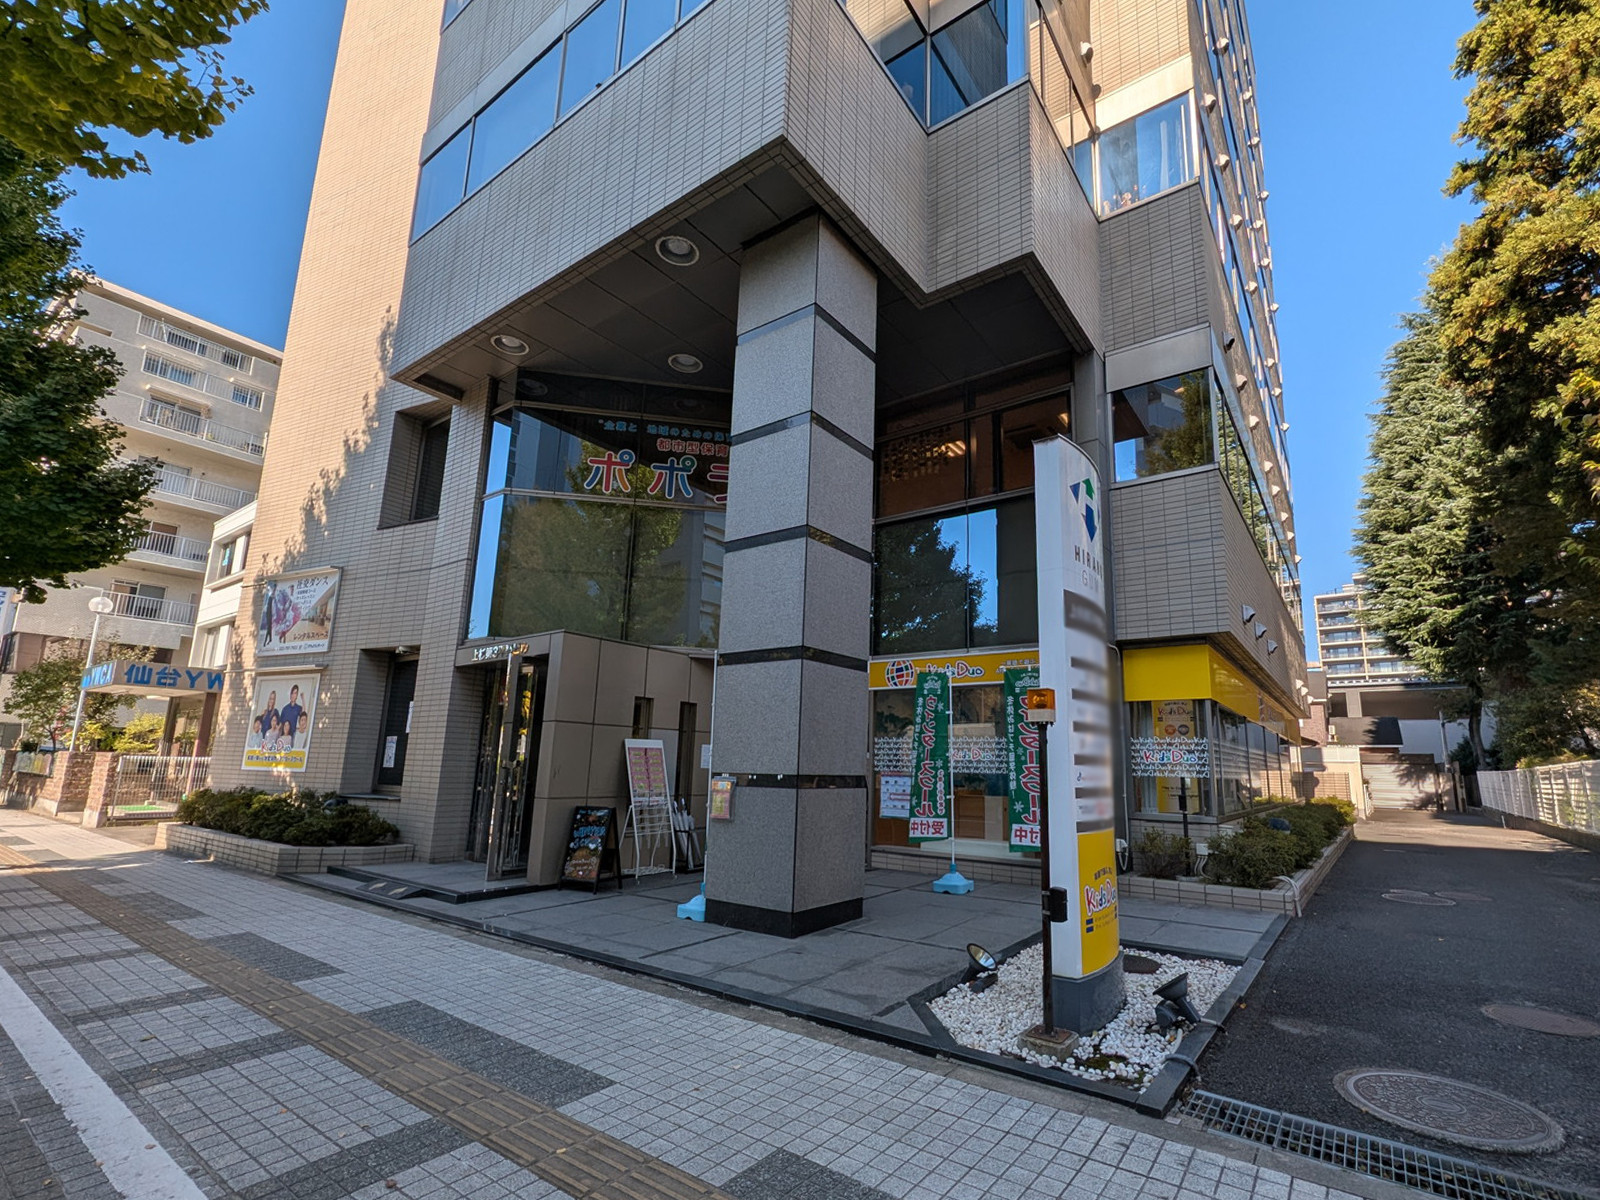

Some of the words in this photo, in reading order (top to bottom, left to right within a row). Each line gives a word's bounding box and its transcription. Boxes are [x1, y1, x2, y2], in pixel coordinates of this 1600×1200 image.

[296, 575, 329, 590] 社交ダンス
[293, 631, 329, 640] レンタルスペース
[1143, 749, 1198, 764] KidsDuo
